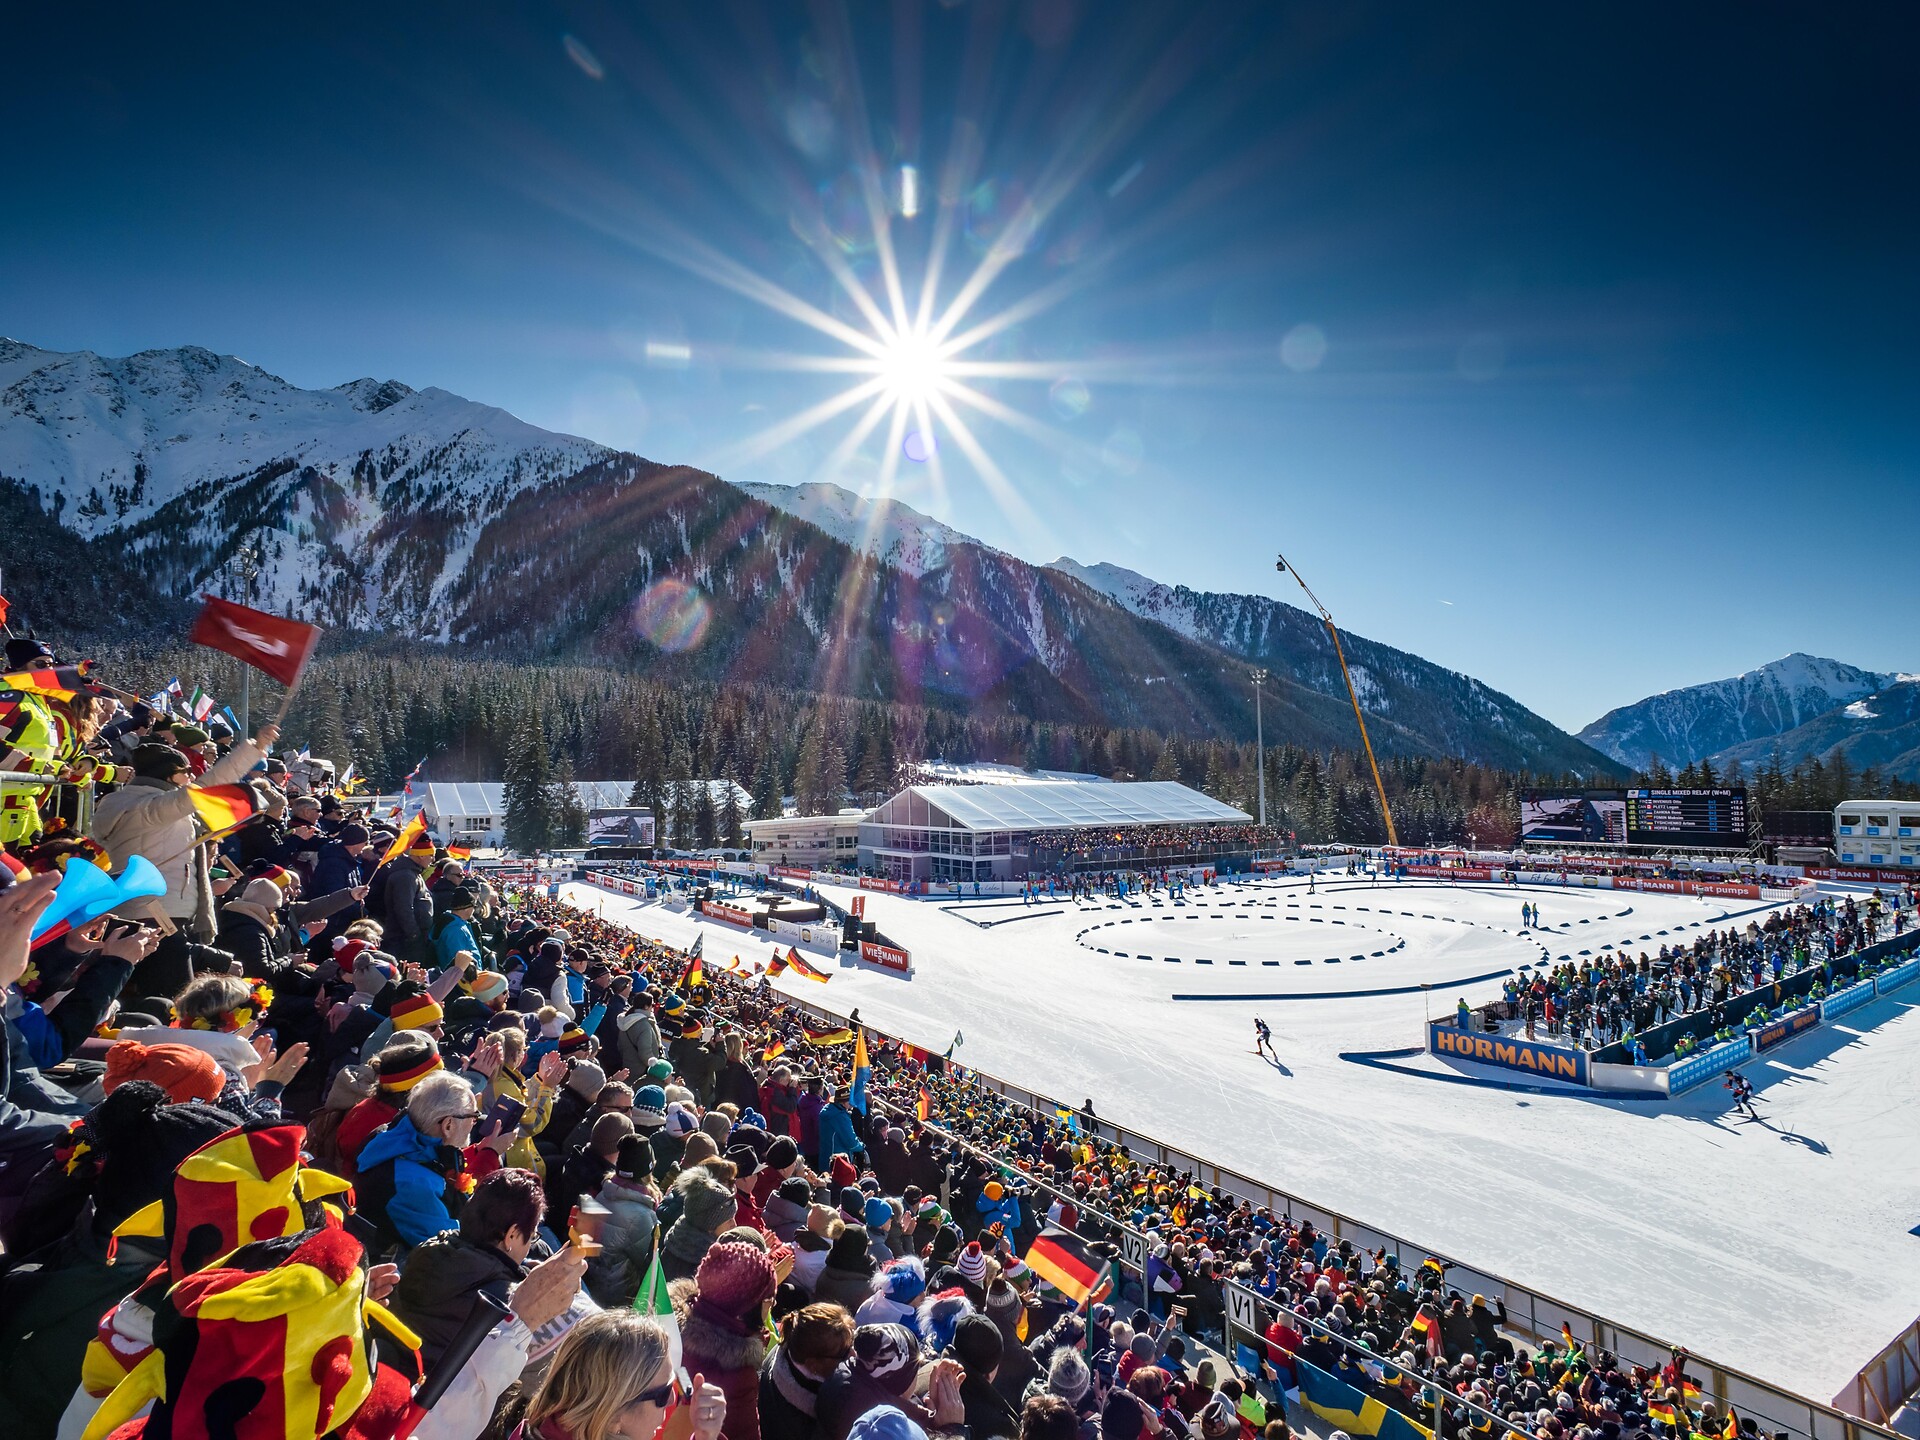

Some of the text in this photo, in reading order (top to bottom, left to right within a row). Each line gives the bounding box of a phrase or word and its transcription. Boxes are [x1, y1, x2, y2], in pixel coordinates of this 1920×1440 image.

[1809, 868, 1871, 880] VIESSMANN
[861, 879, 885, 890] VIESSMANN
[1617, 879, 1675, 892] VIESSMANN
[1691, 883, 1749, 896] Hat pumps
[865, 946, 904, 965] VIESSMANN
[1437, 1031, 1577, 1078] HÖRMANN
[1124, 1234, 1142, 1265] V2
[1231, 1290, 1251, 1325] V1
